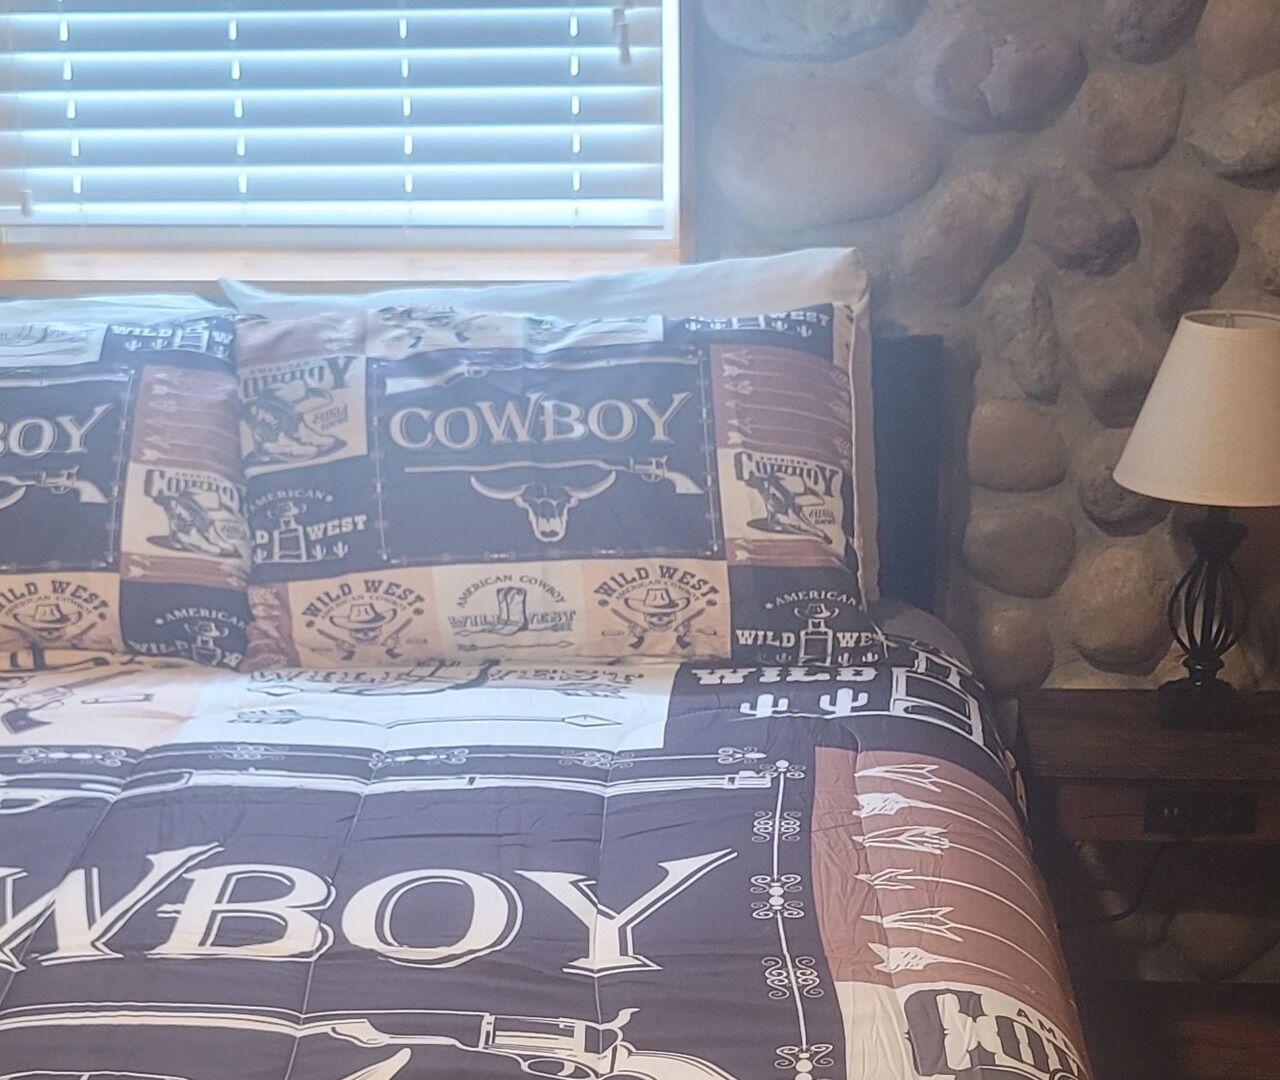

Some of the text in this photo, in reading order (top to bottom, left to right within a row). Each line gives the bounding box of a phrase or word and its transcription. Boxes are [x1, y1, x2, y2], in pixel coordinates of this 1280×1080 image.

[388, 391, 691, 451] COWBOY
[249, 489, 326, 512] AMERICAN
[306, 515, 367, 541] WEST
[51, 580, 109, 610] WEST
[456, 575, 567, 608] AMERICAN COWBOY
[594, 565, 720, 598] WILD WEST
[301, 580, 425, 618] WILD WEST
[775, 590, 857, 606] AMERICAN
[736, 629, 796, 648] WILD
[690, 666, 880, 685] WILD
